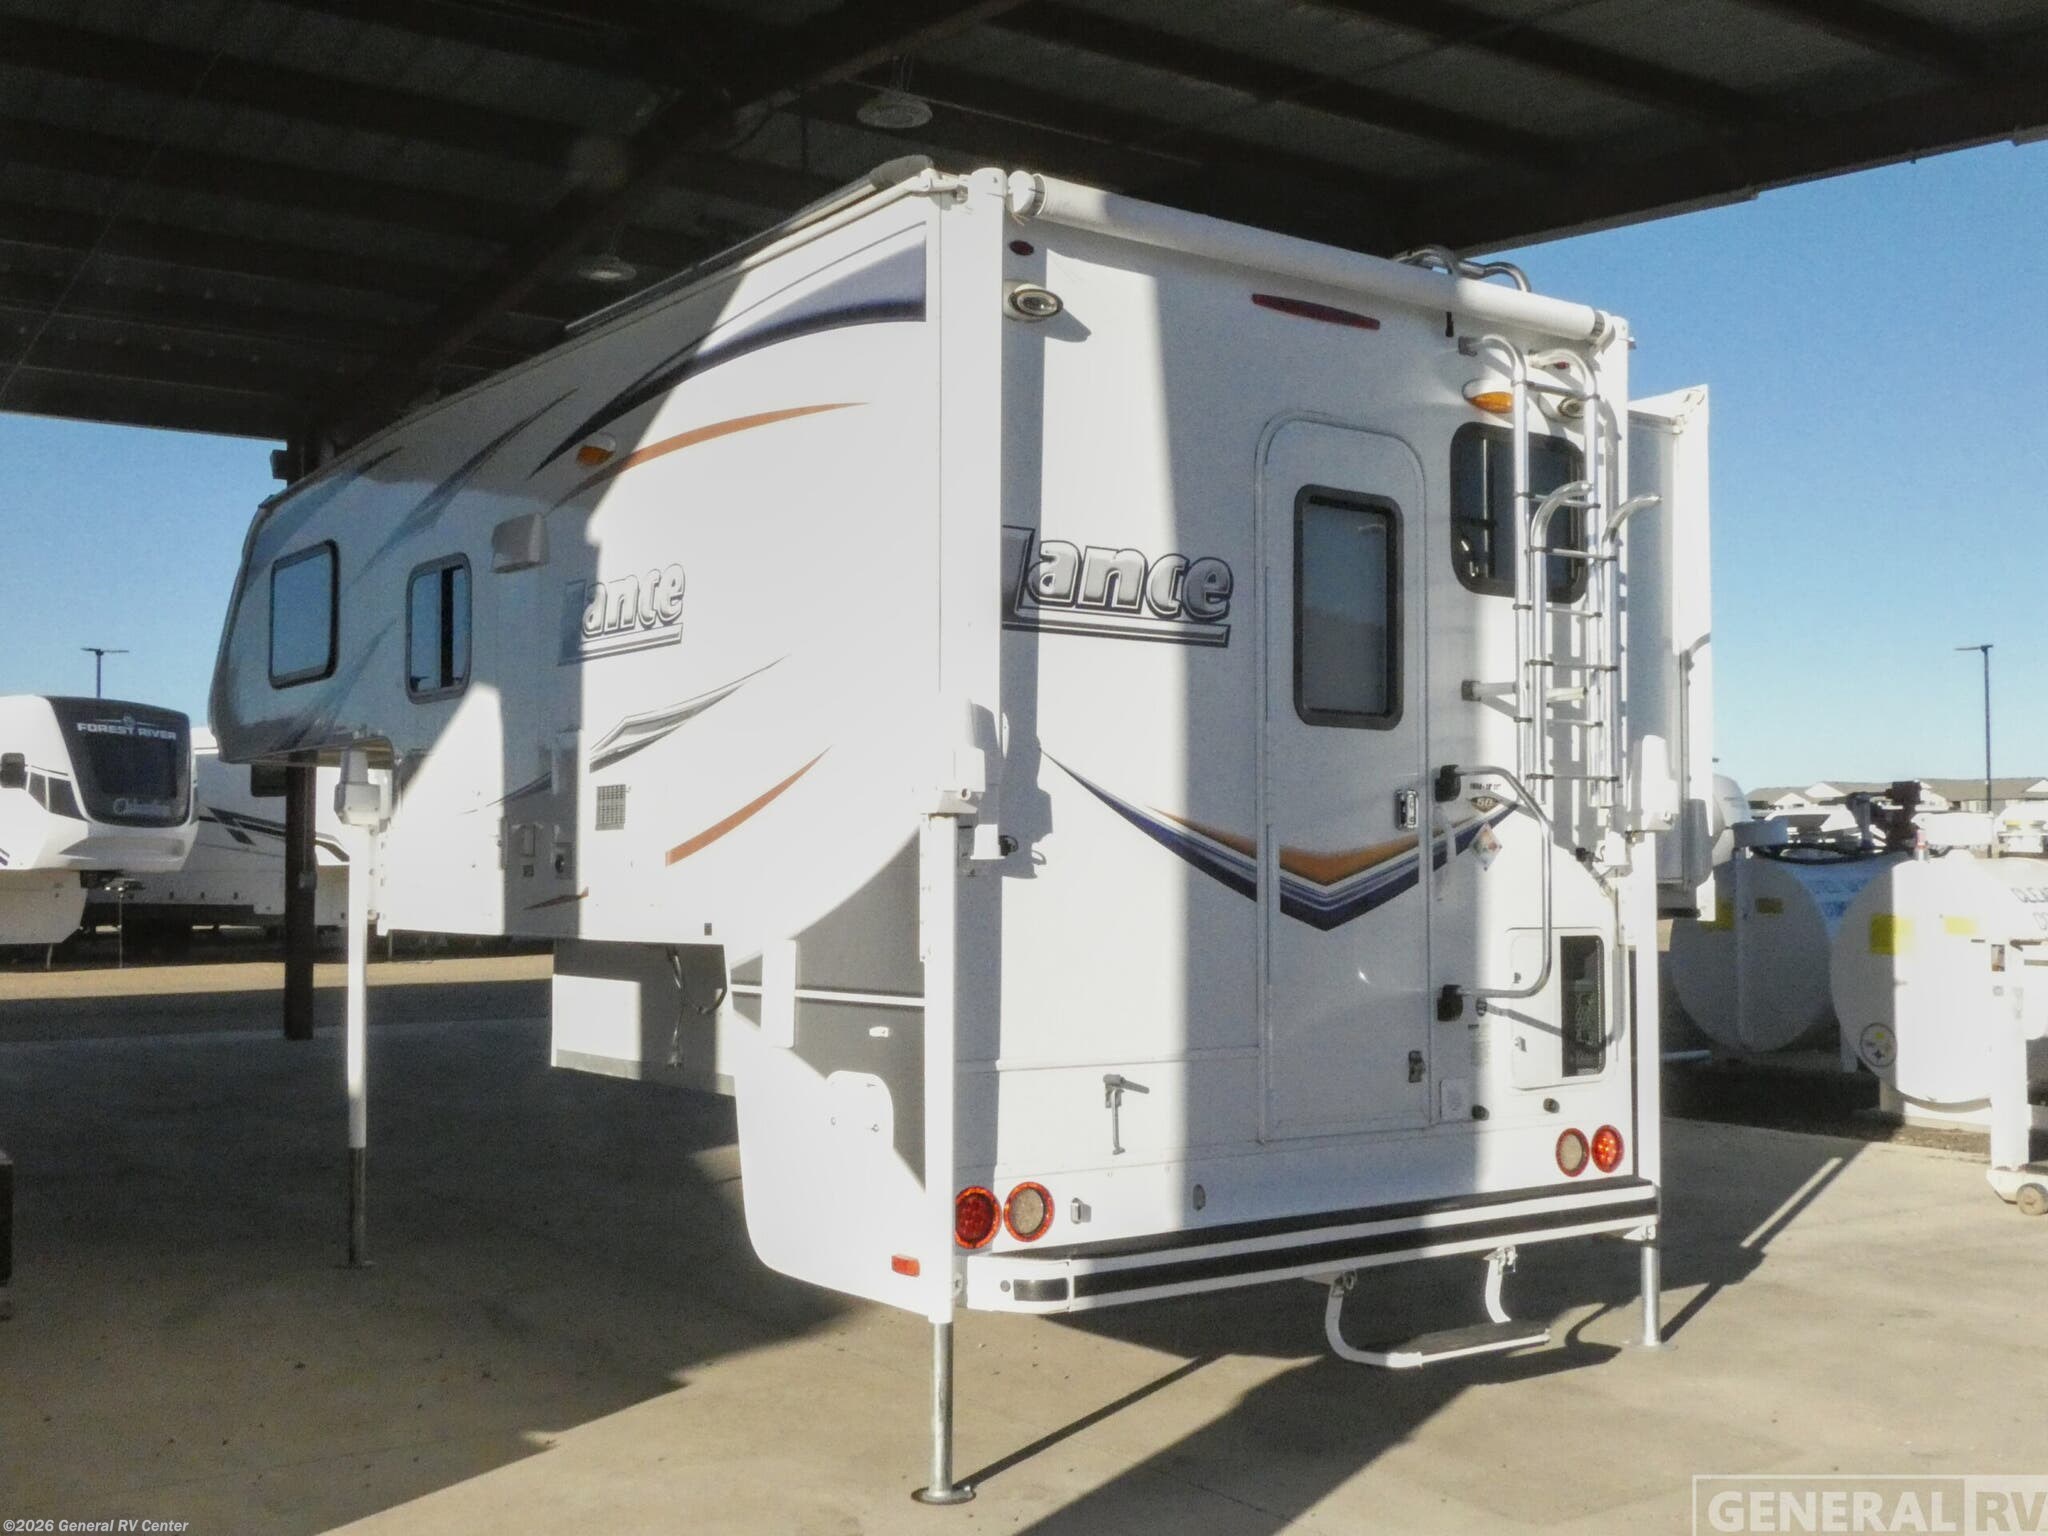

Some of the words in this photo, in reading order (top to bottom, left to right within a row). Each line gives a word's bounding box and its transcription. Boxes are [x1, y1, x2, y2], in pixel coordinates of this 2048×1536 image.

[557, 563, 685, 666] Lance
[1001, 525, 1234, 648] Lance
[77, 722, 135, 735] FOREST
[138, 728, 177, 740] RIVER
